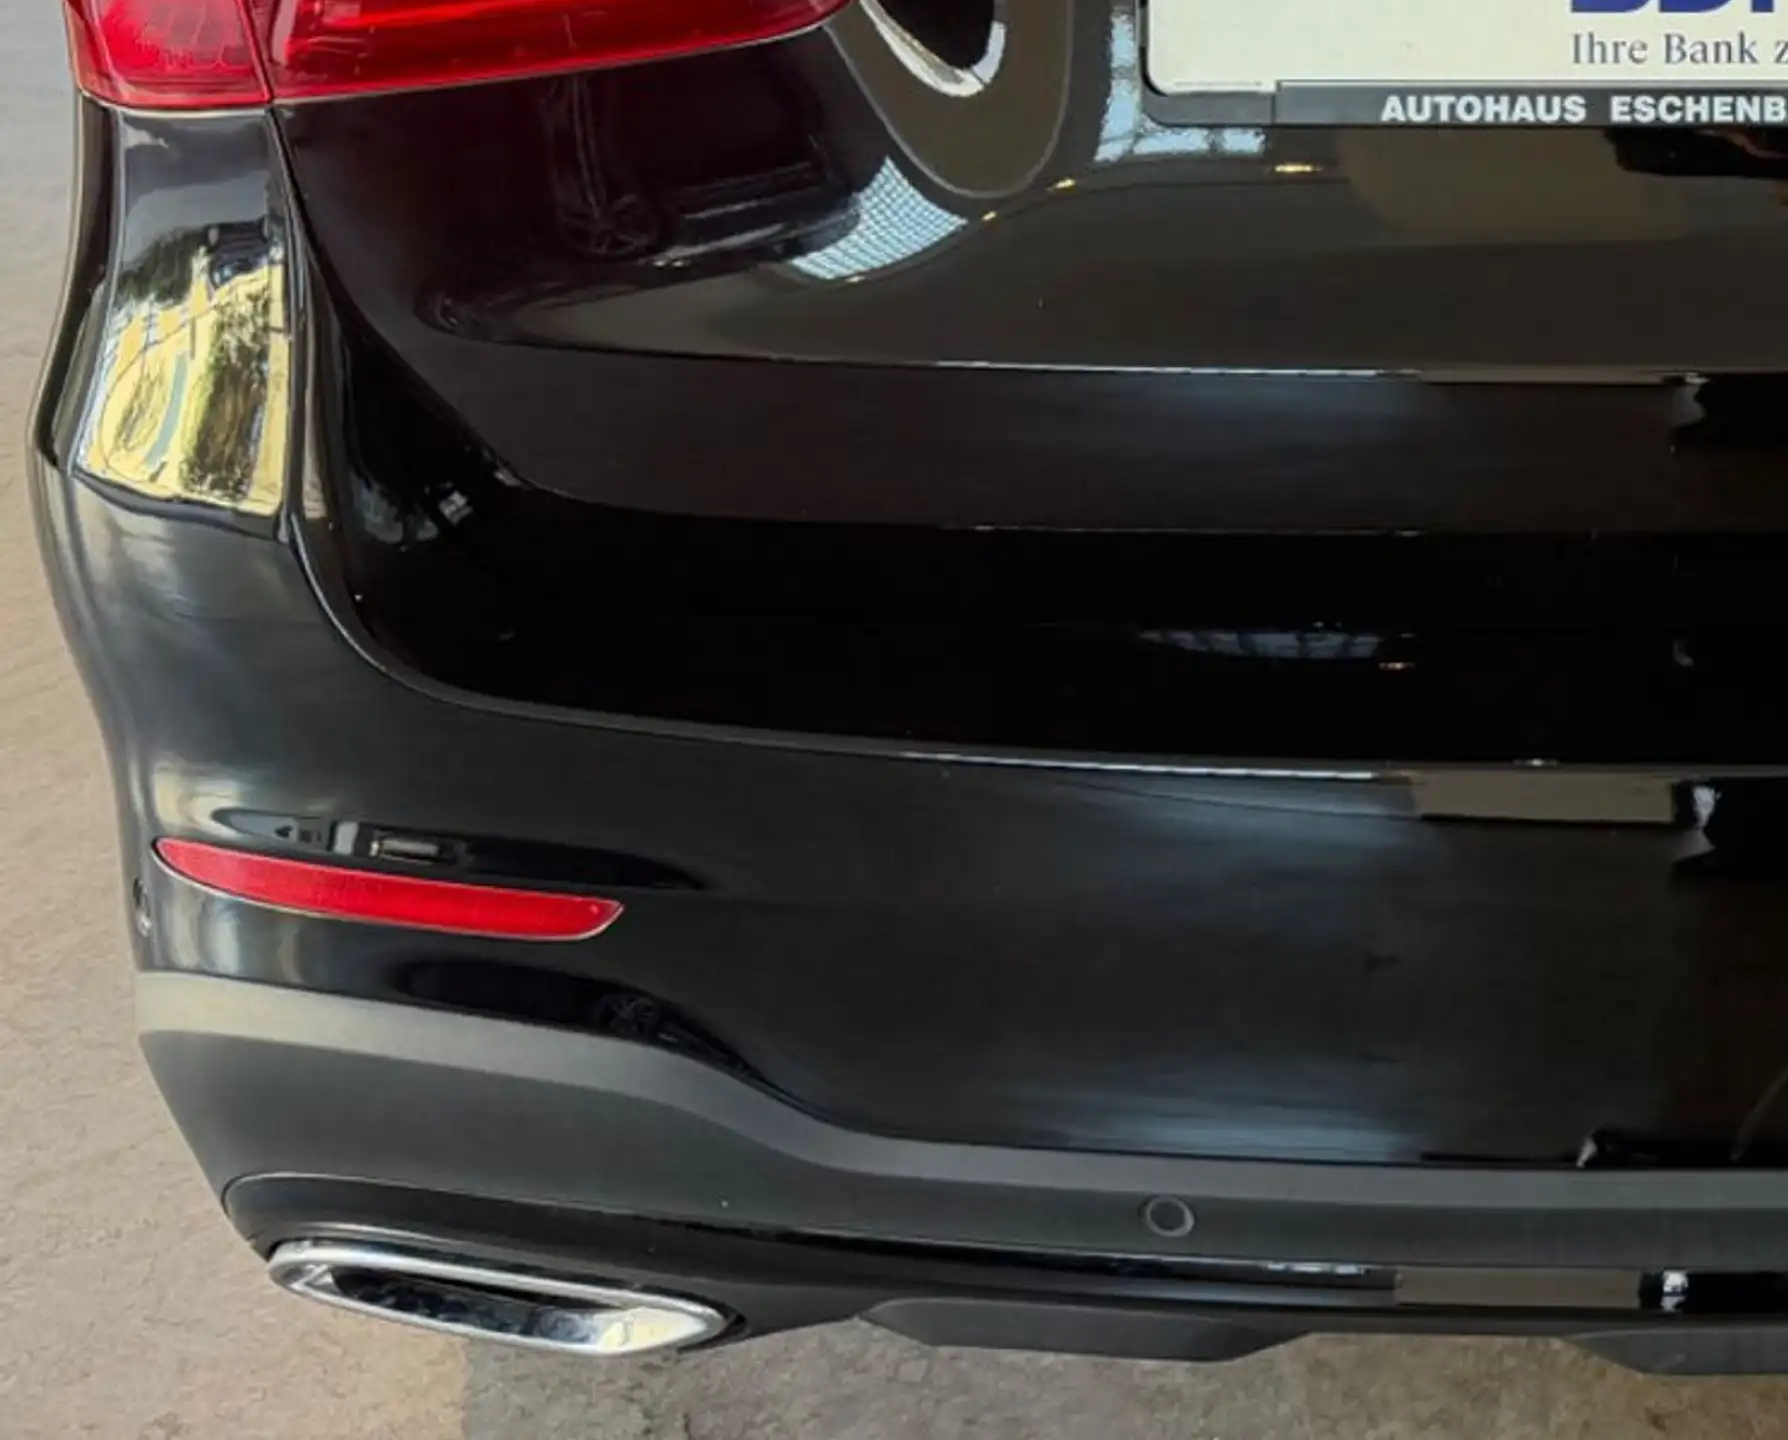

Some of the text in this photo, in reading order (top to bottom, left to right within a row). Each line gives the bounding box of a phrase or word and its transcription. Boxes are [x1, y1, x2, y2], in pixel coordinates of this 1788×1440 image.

[1571, 33, 1648, 64] Ihre
[1664, 32, 1758, 64] Bank
[1380, 95, 1588, 123] AUTOHAUS
